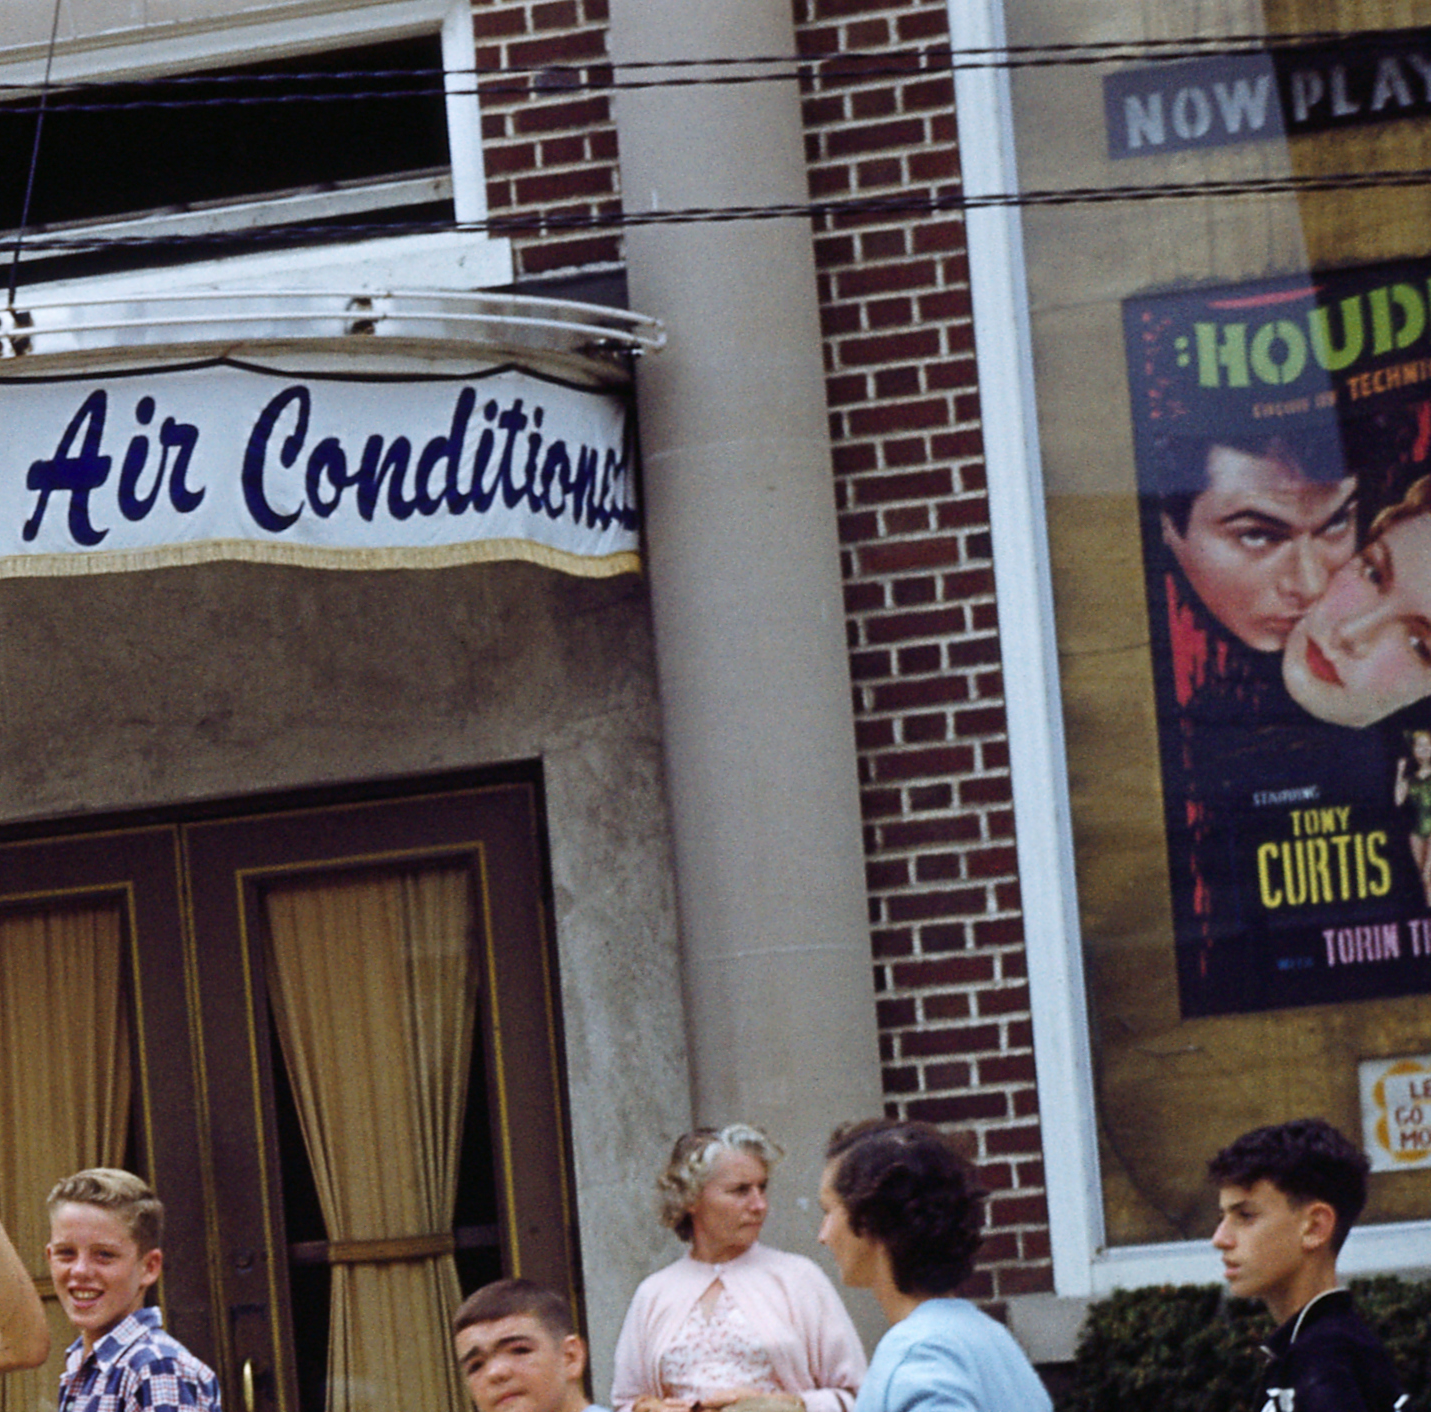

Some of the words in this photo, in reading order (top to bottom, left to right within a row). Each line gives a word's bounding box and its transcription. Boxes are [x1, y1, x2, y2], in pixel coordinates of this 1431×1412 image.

[1124, 74, 1271, 149] NOW
[1193, 278, 1431, 388] HOUD
[22, 389, 206, 547] Air
[1289, 806, 1352, 837] TONY
[1257, 830, 1392, 909] CURTIS
[1321, 922, 1400, 968] TORIN
